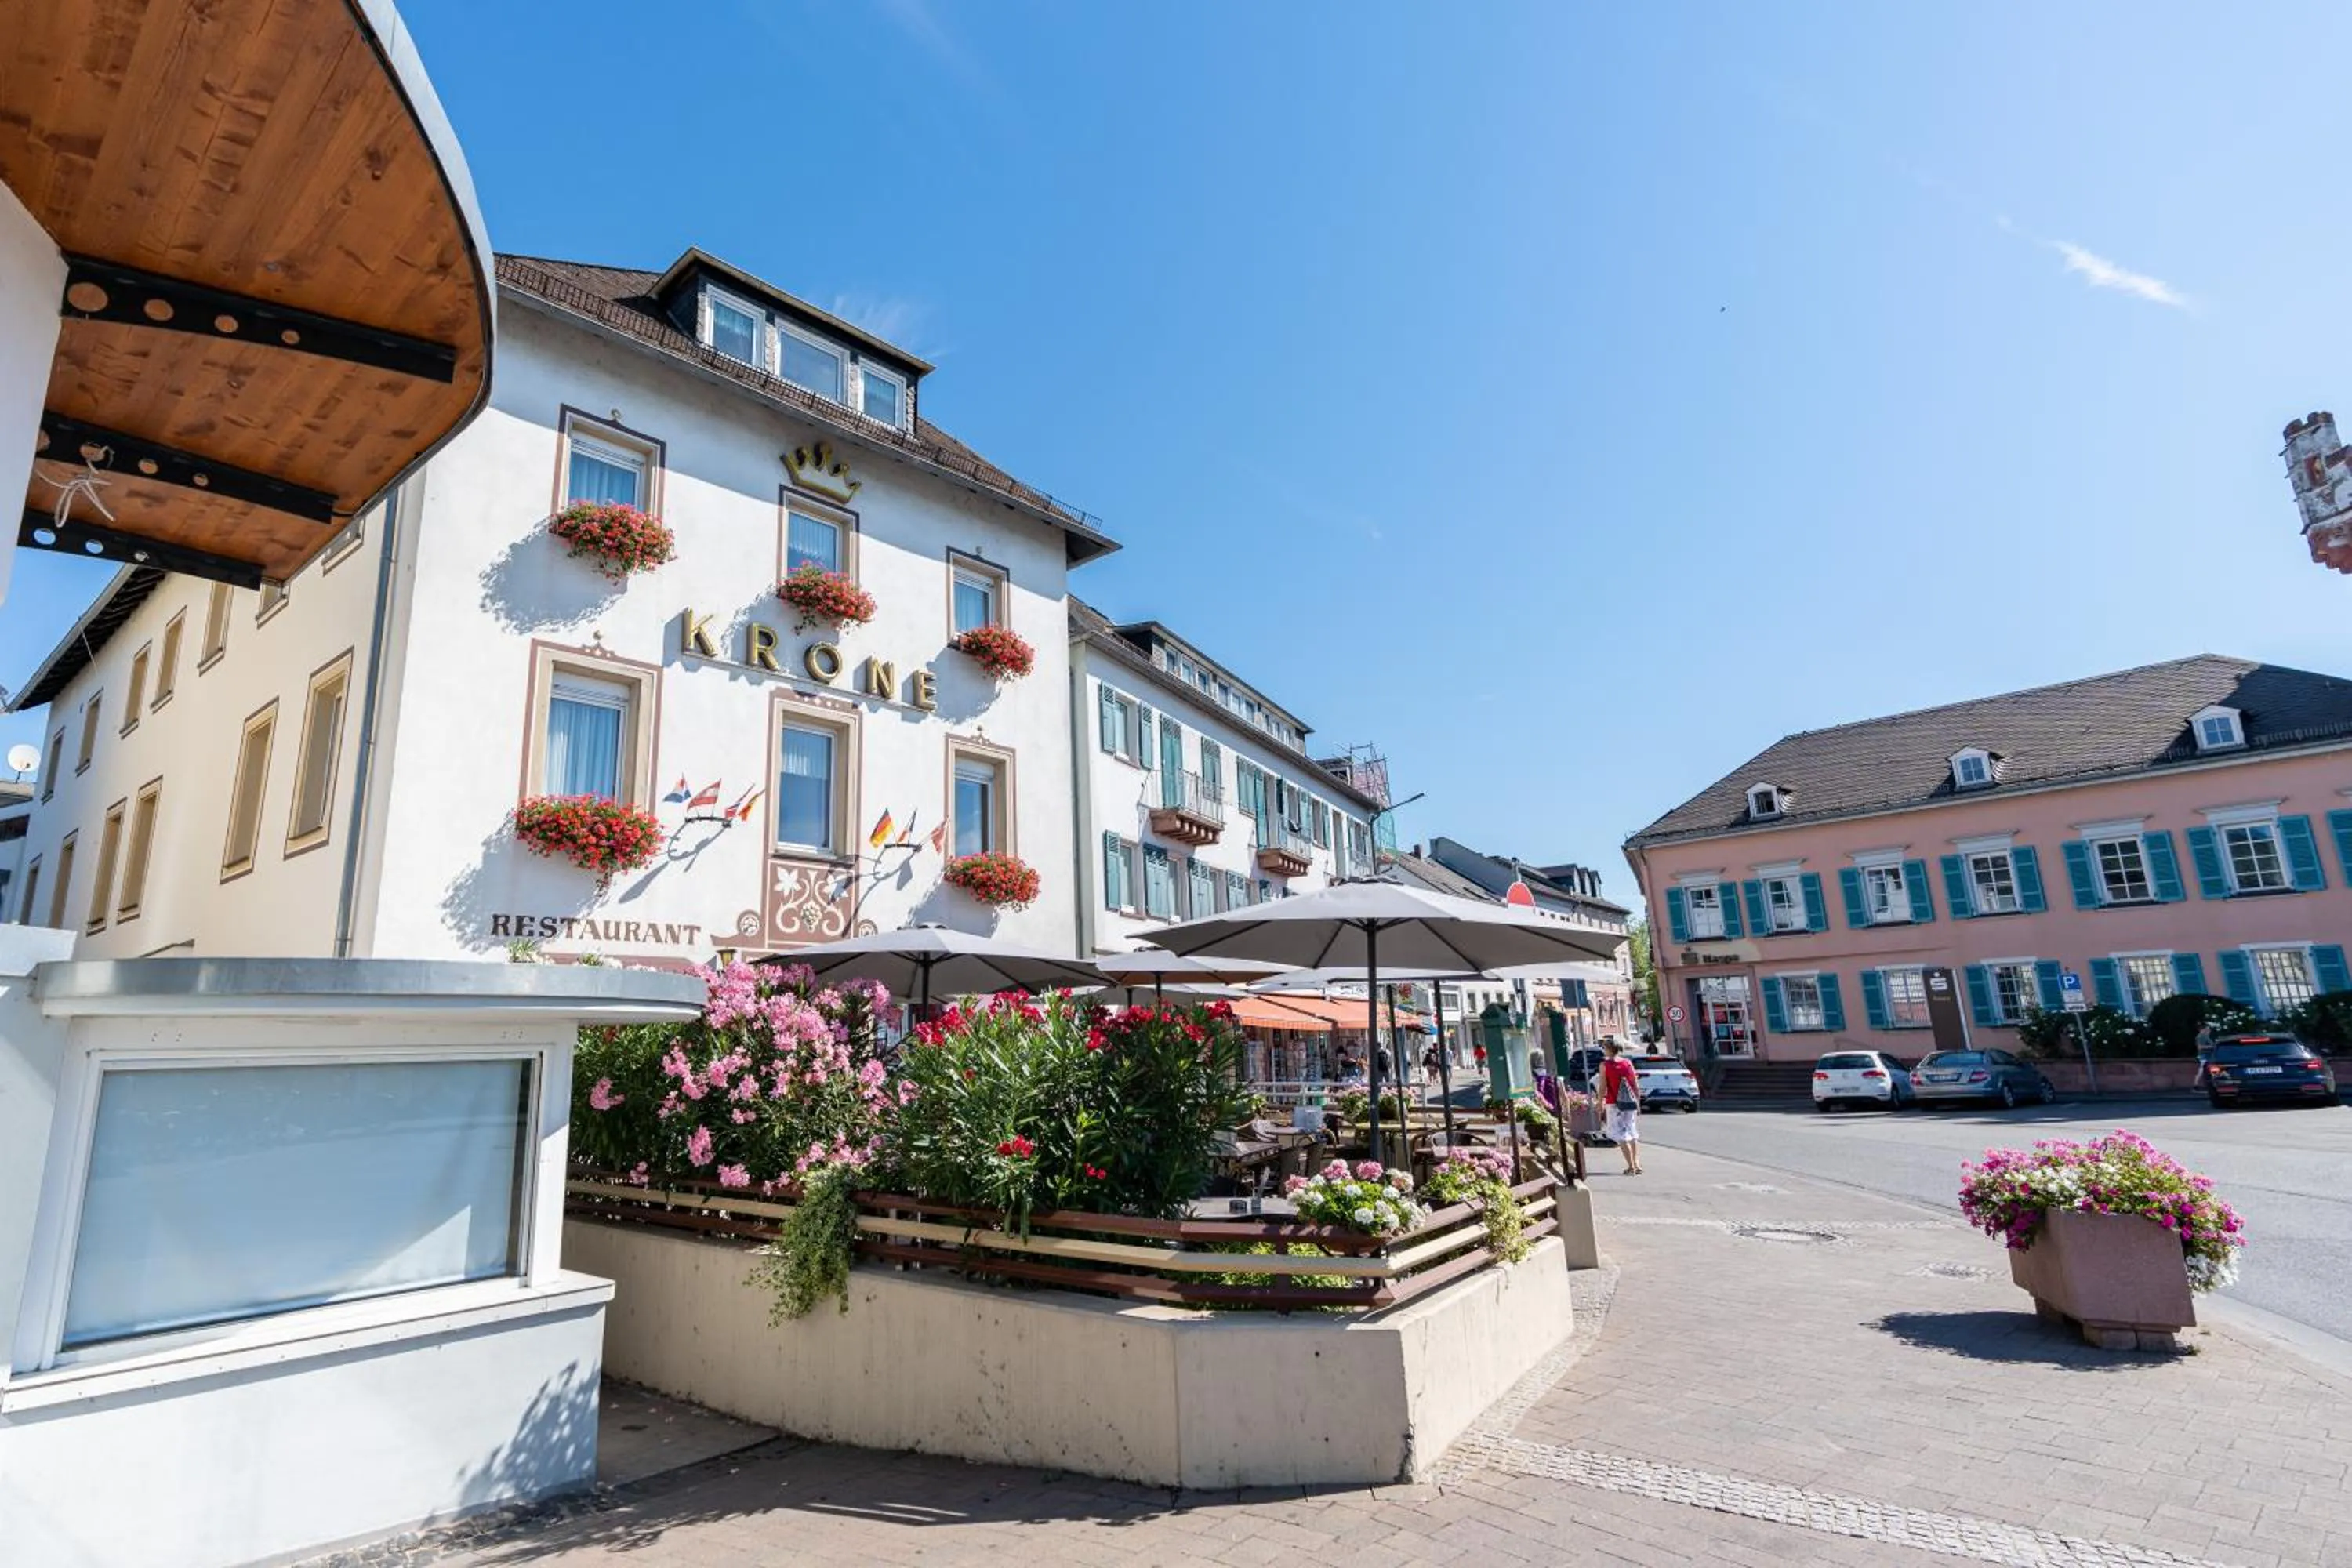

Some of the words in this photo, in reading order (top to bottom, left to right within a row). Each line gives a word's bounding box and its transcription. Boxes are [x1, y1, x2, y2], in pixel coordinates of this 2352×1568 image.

[682, 607, 938, 711] KRONE
[491, 913, 702, 946] RESTAURANT
[2063, 976, 2075, 989] P
[1671, 1009, 1682, 1018] 30
